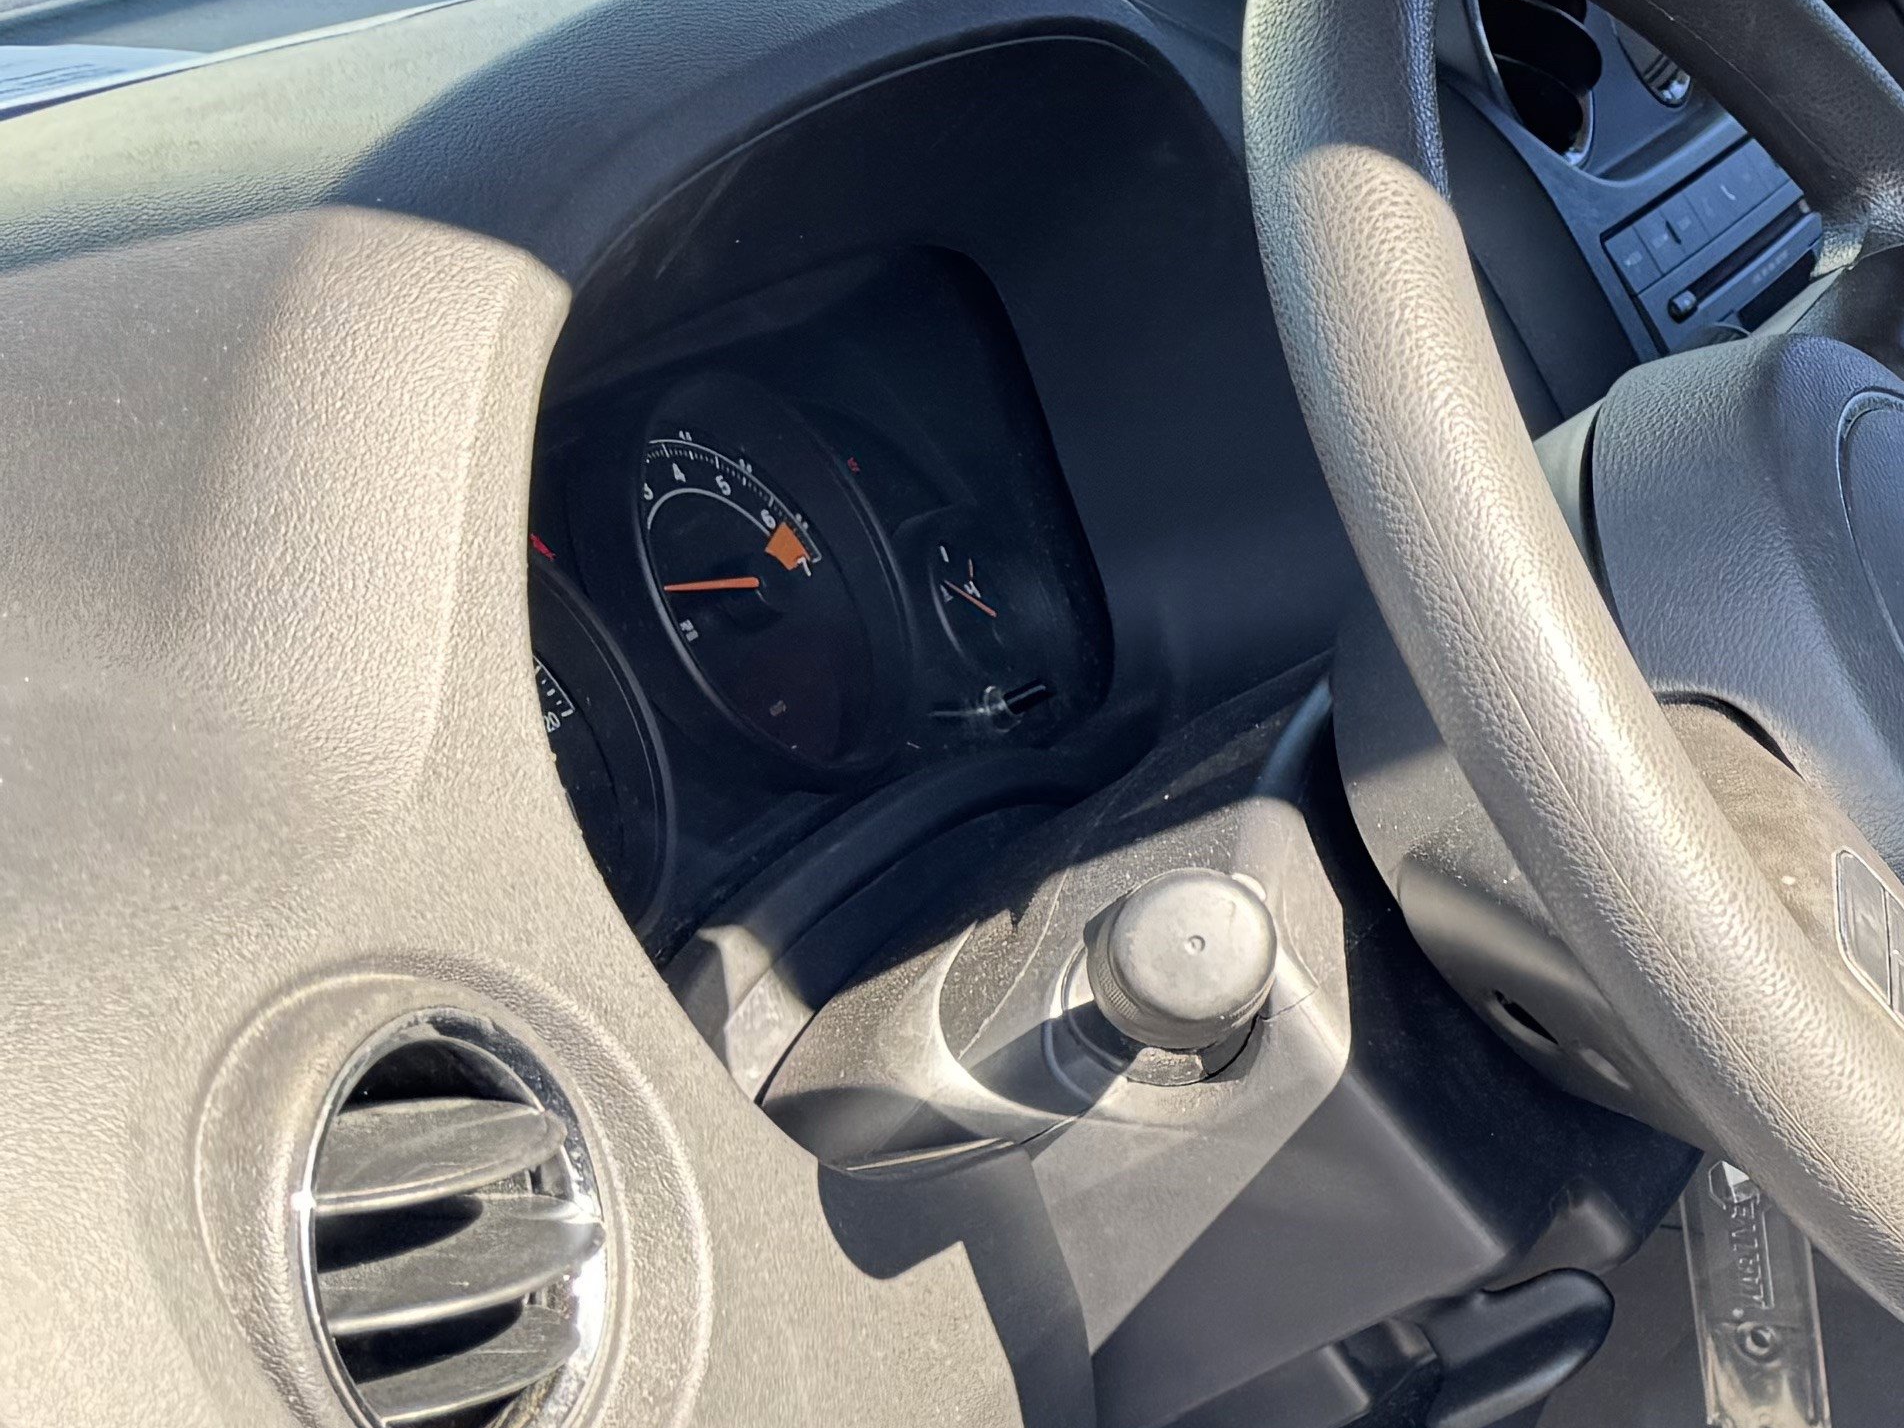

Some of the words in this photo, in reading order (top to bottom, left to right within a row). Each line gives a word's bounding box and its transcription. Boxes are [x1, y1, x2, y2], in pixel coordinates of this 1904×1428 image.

[715, 474, 731, 496] 5
[760, 508, 776, 529] 6
[796, 555, 812, 577] 7
